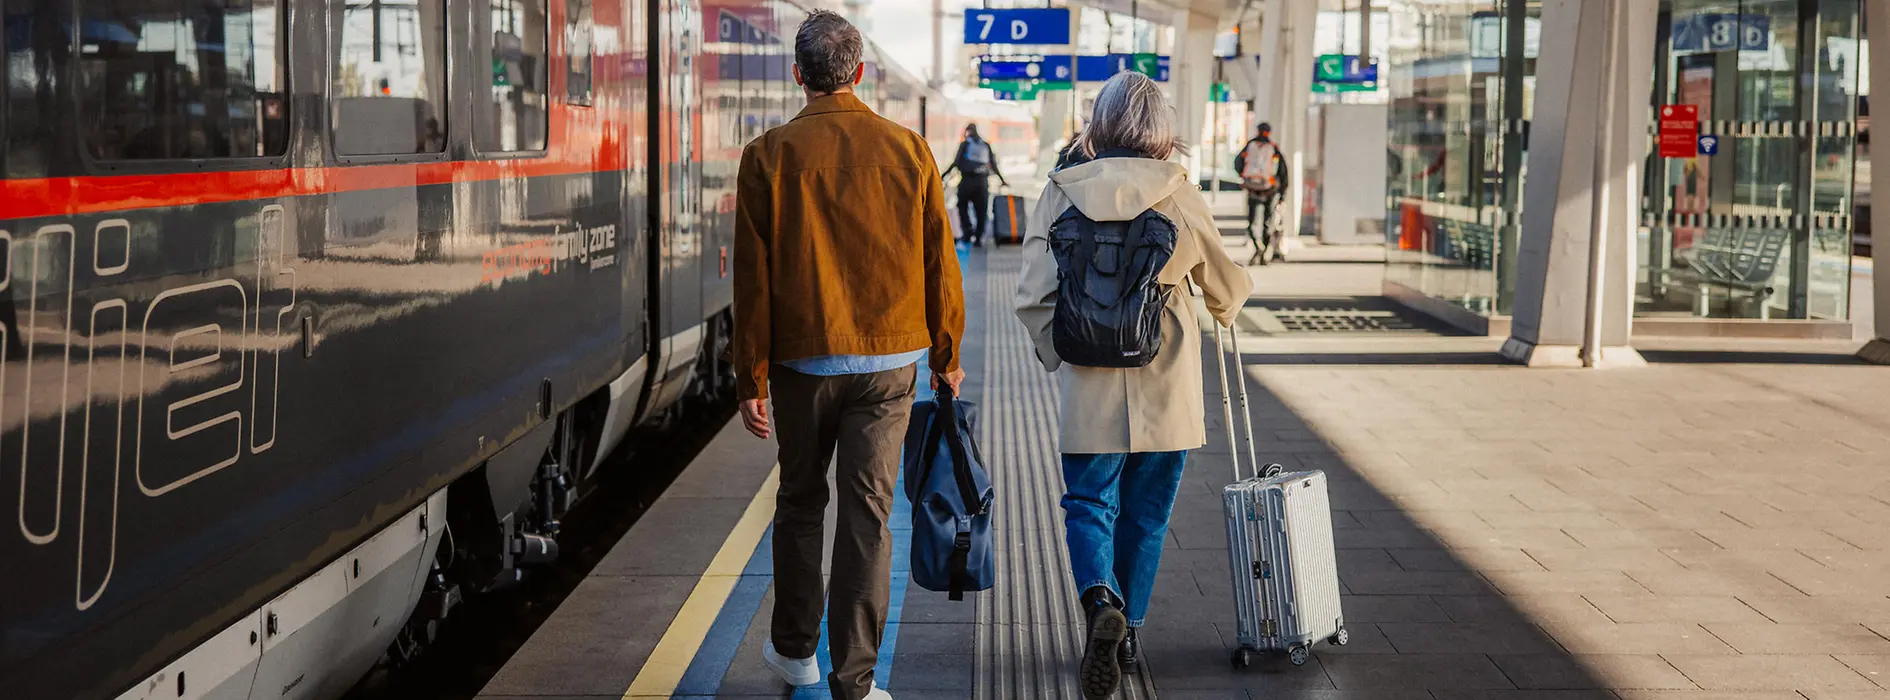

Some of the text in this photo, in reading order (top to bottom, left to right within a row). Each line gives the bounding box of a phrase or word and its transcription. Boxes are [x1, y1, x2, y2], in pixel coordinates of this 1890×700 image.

[976, 14, 1028, 41] 7 D
[1711, 21, 1763, 47] 8 D
[553, 221, 589, 274] family
[589, 224, 616, 252] zone
